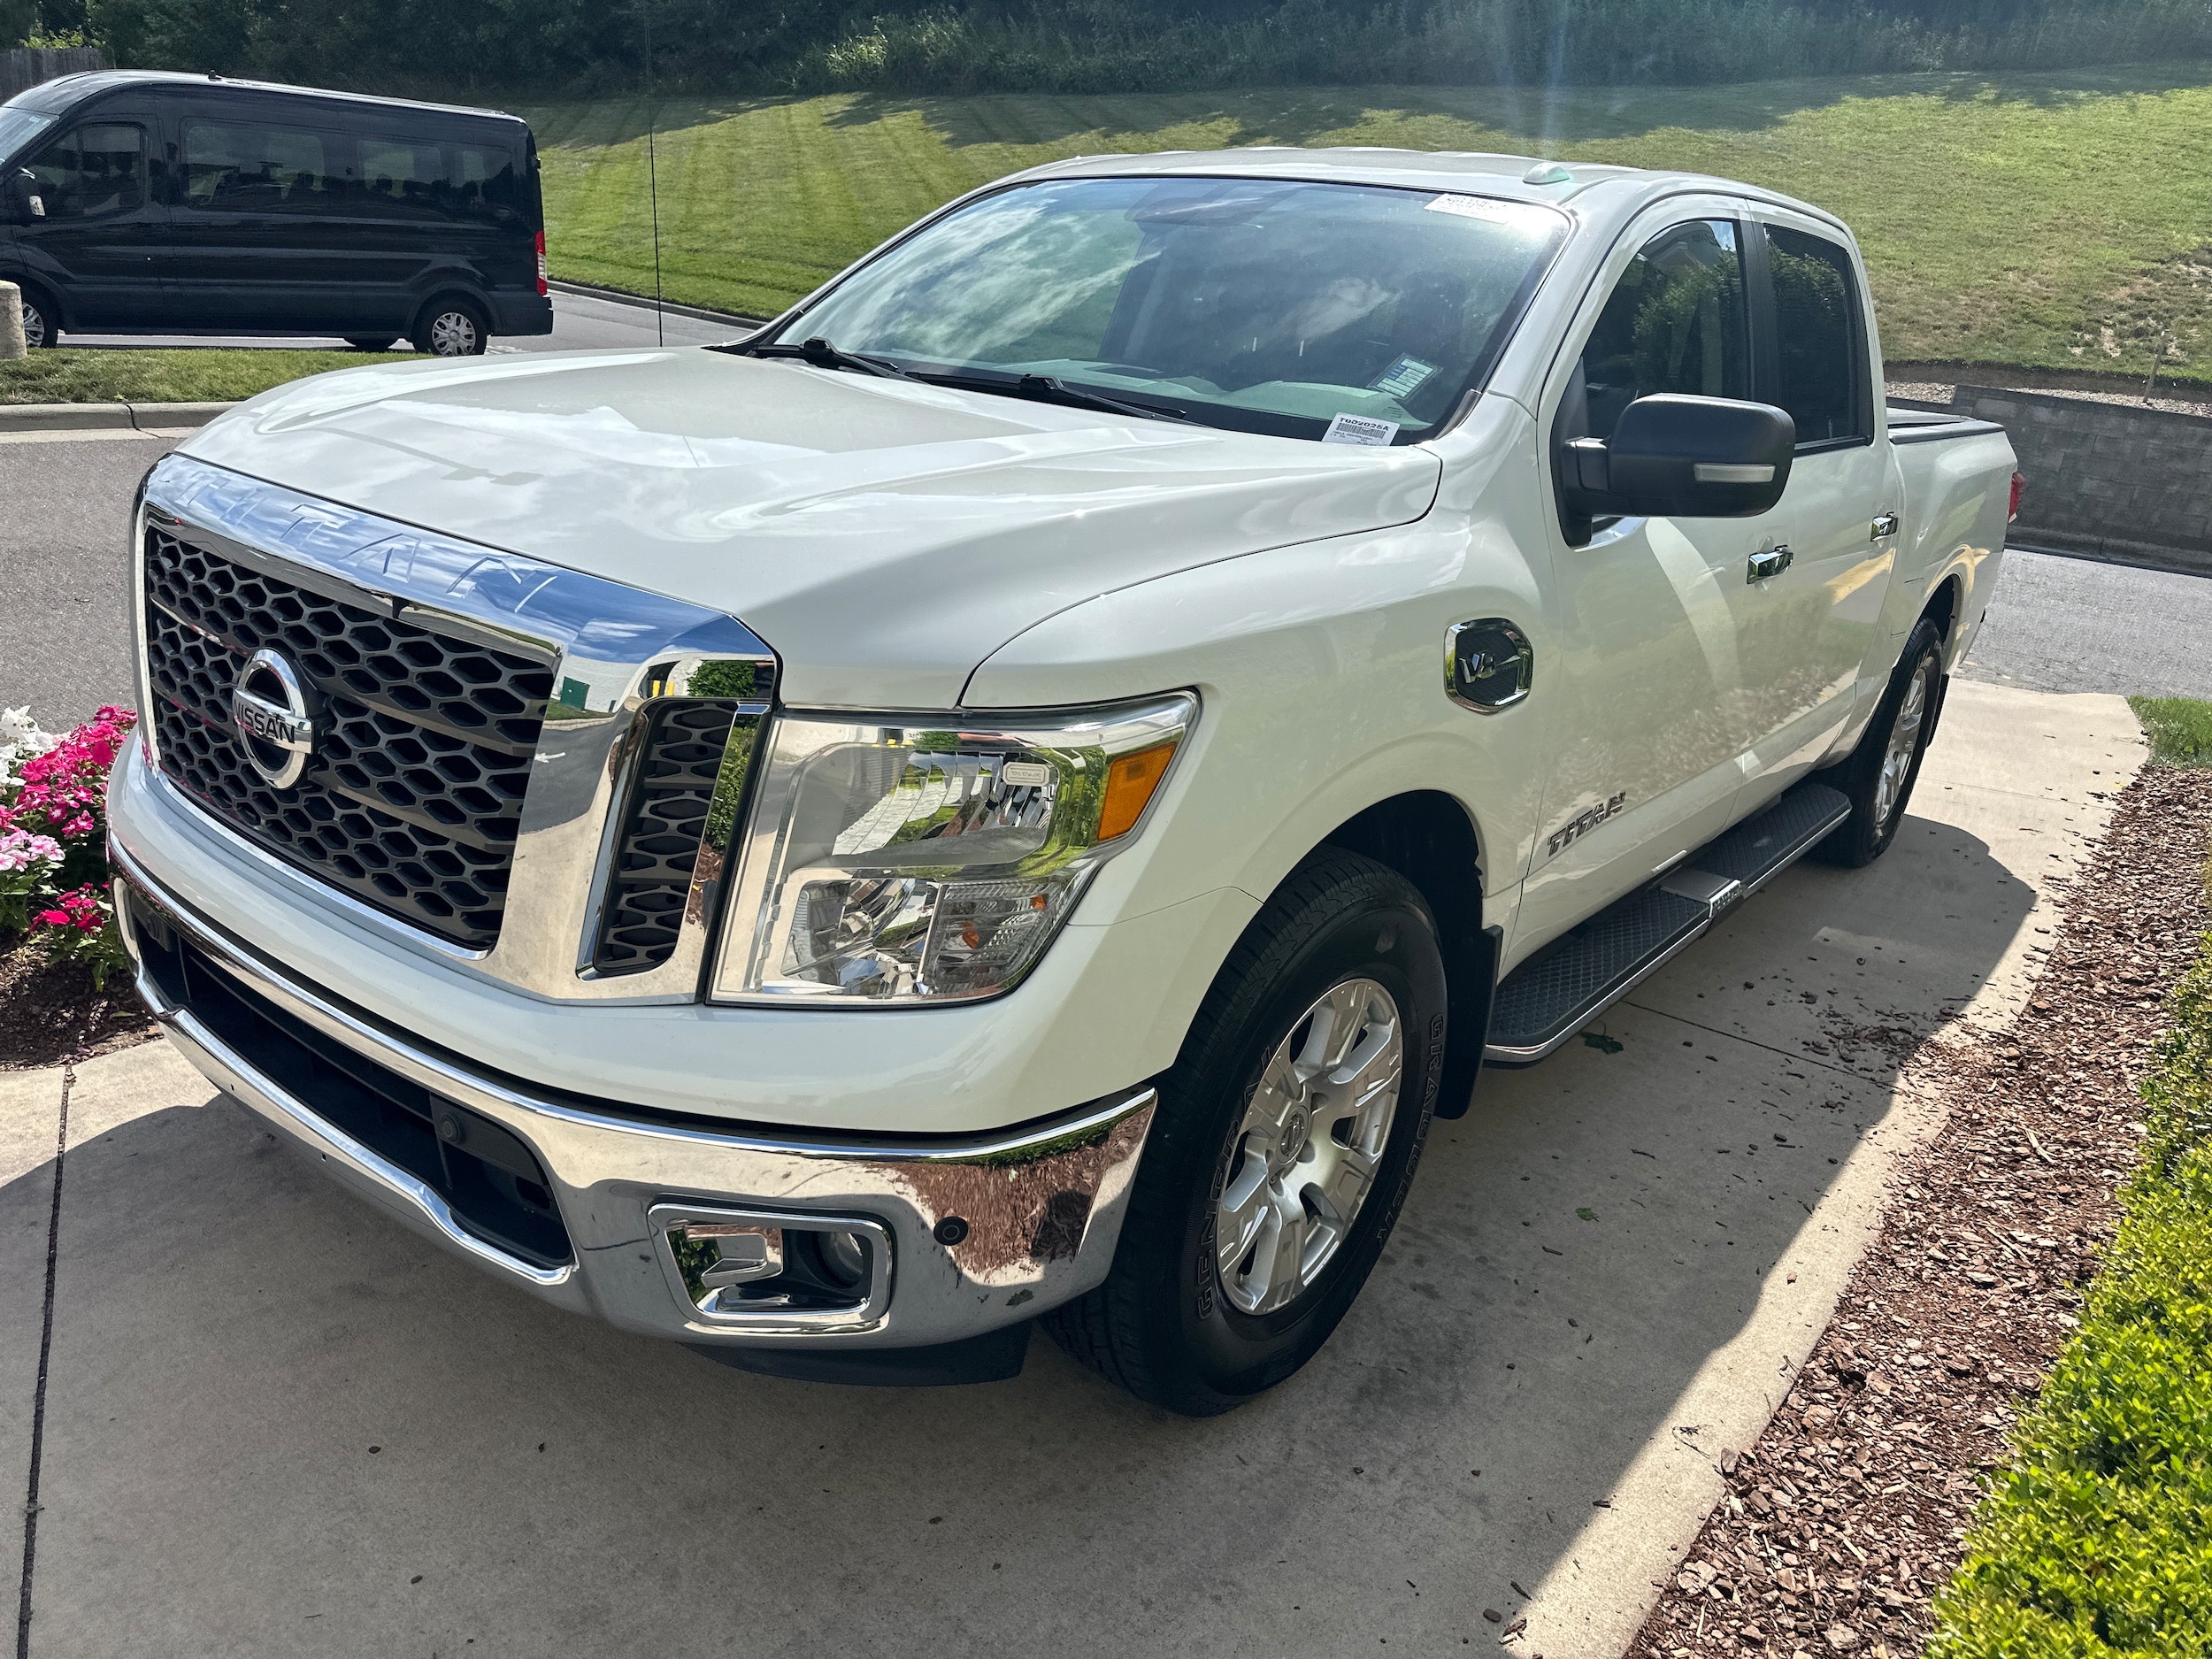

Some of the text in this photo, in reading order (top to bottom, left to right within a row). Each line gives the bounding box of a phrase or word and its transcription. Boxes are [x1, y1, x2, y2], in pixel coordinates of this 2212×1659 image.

[174, 470, 557, 613] TITAN
[1458, 649, 1496, 683] V8
[234, 698, 296, 744] NISSAN
[1547, 790, 1626, 857] TITAN
